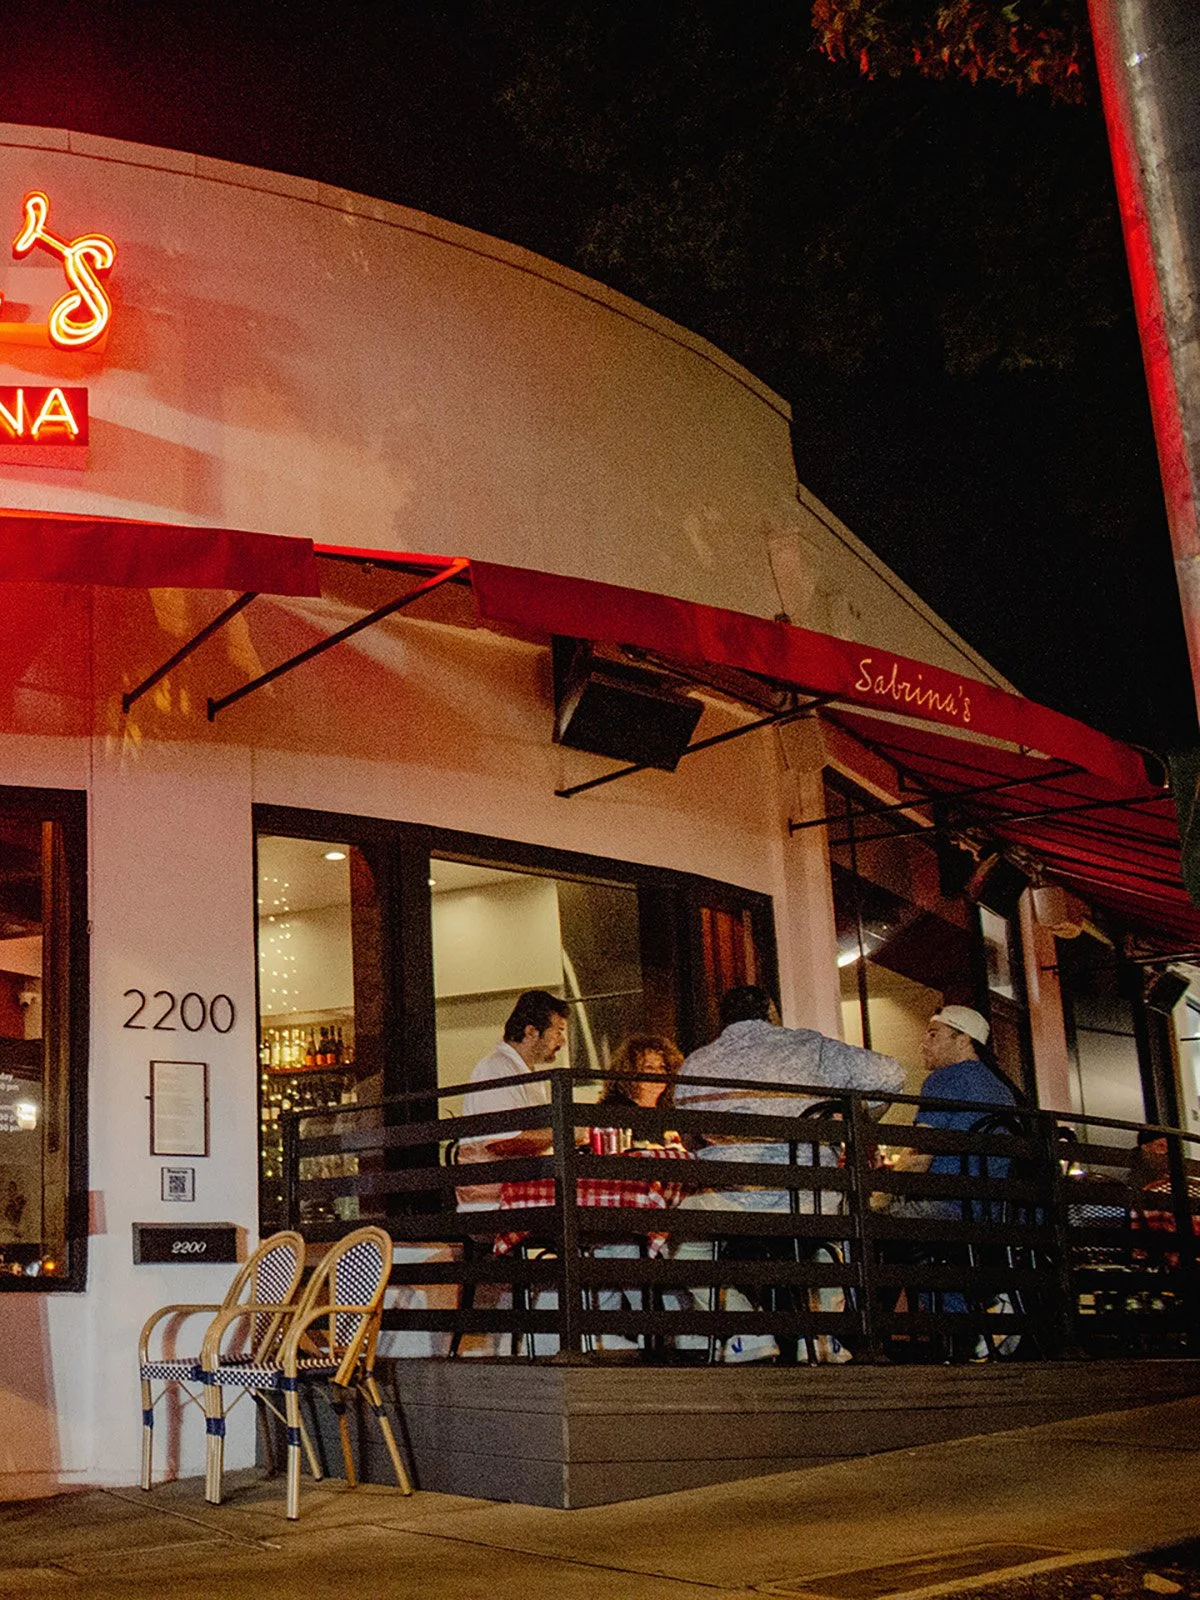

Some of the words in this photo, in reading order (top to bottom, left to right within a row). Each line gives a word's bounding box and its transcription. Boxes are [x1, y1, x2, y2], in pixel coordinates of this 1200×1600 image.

[855, 659, 971, 722] Sabrina's
[122, 989, 236, 1034] 2200
[6, 1083, 20, 1092] pm
[171, 1241, 207, 1254] 2200
